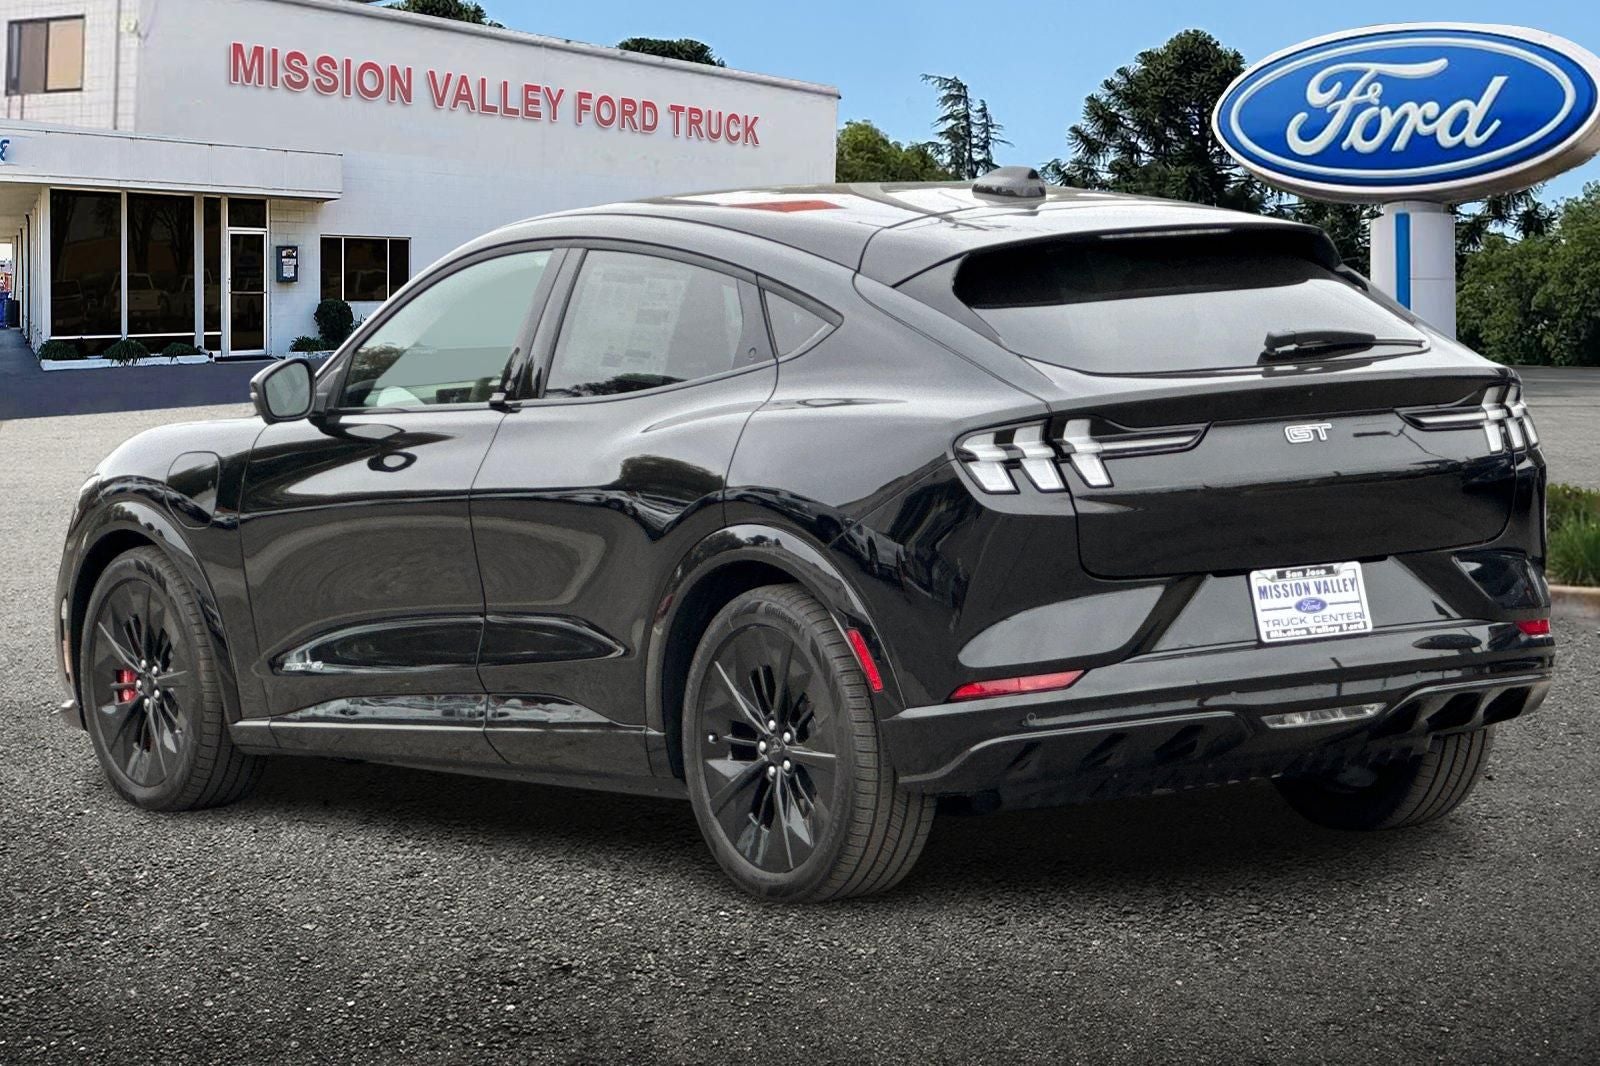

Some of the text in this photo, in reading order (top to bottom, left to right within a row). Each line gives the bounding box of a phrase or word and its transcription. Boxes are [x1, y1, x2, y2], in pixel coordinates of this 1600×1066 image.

[229, 41, 760, 146] MISSION VALLEY FORD TRUCK
[1286, 57, 1510, 156] Ford
[1284, 422, 1332, 443] GT
[1285, 570, 1303, 579] San
[1258, 577, 1356, 600] MISSION VALLEY
[1264, 612, 1364, 628] TRUCK CENTER
